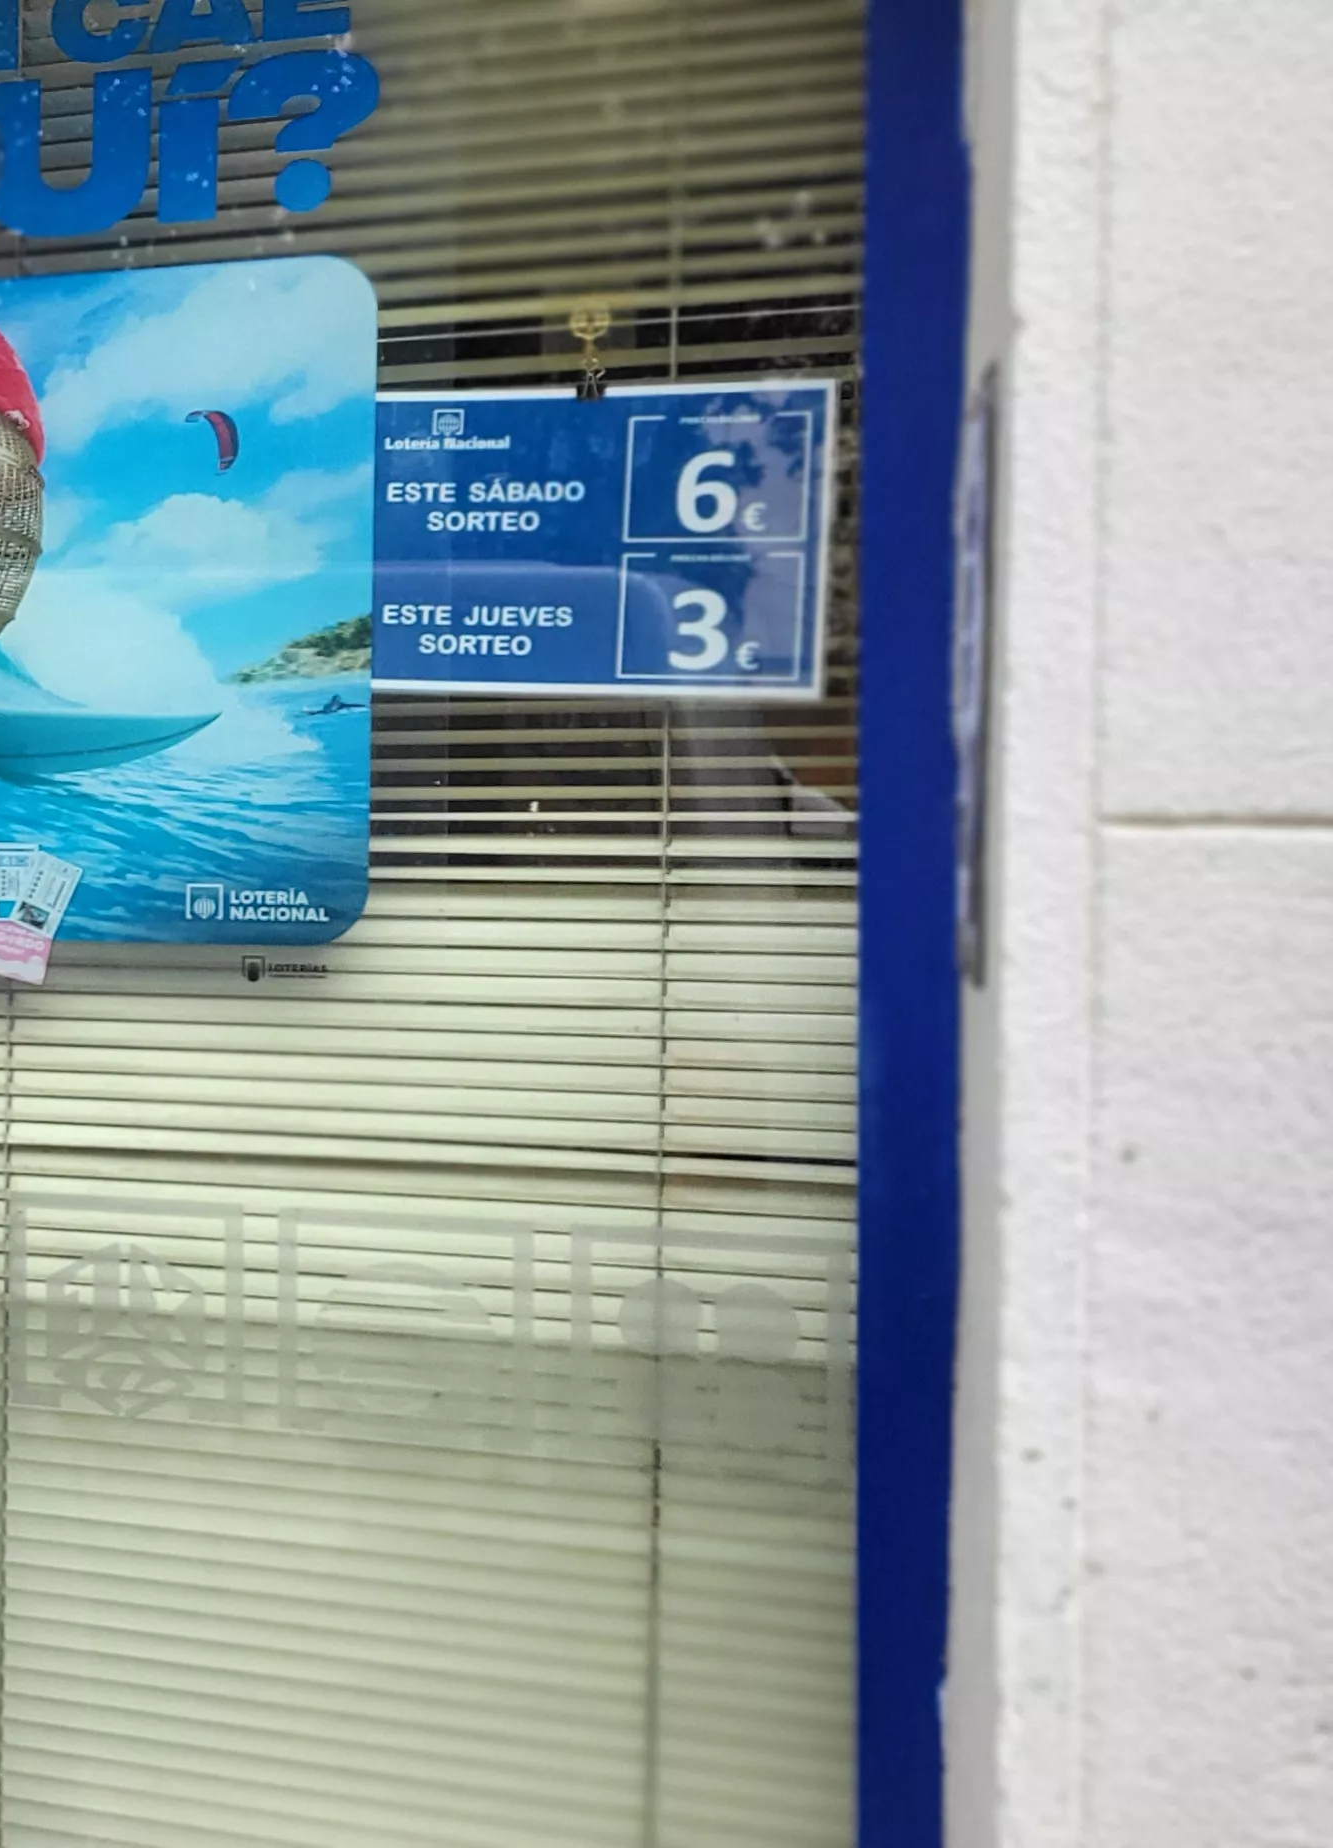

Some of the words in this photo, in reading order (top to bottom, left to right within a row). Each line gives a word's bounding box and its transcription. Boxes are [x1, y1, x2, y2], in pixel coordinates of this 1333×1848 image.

[384, 436, 440, 450] Lotería
[443, 435, 511, 449] Nacional
[387, 482, 457, 503] ESTE
[468, 477, 586, 503] SÁBADO
[426, 511, 540, 532] SORTEO
[382, 604, 452, 626] ESTE
[463, 605, 573, 627] JUEVES
[418, 633, 532, 656] SORTEO
[229, 887, 309, 906] LOTERÍA
[229, 906, 330, 922] NACIONAL
